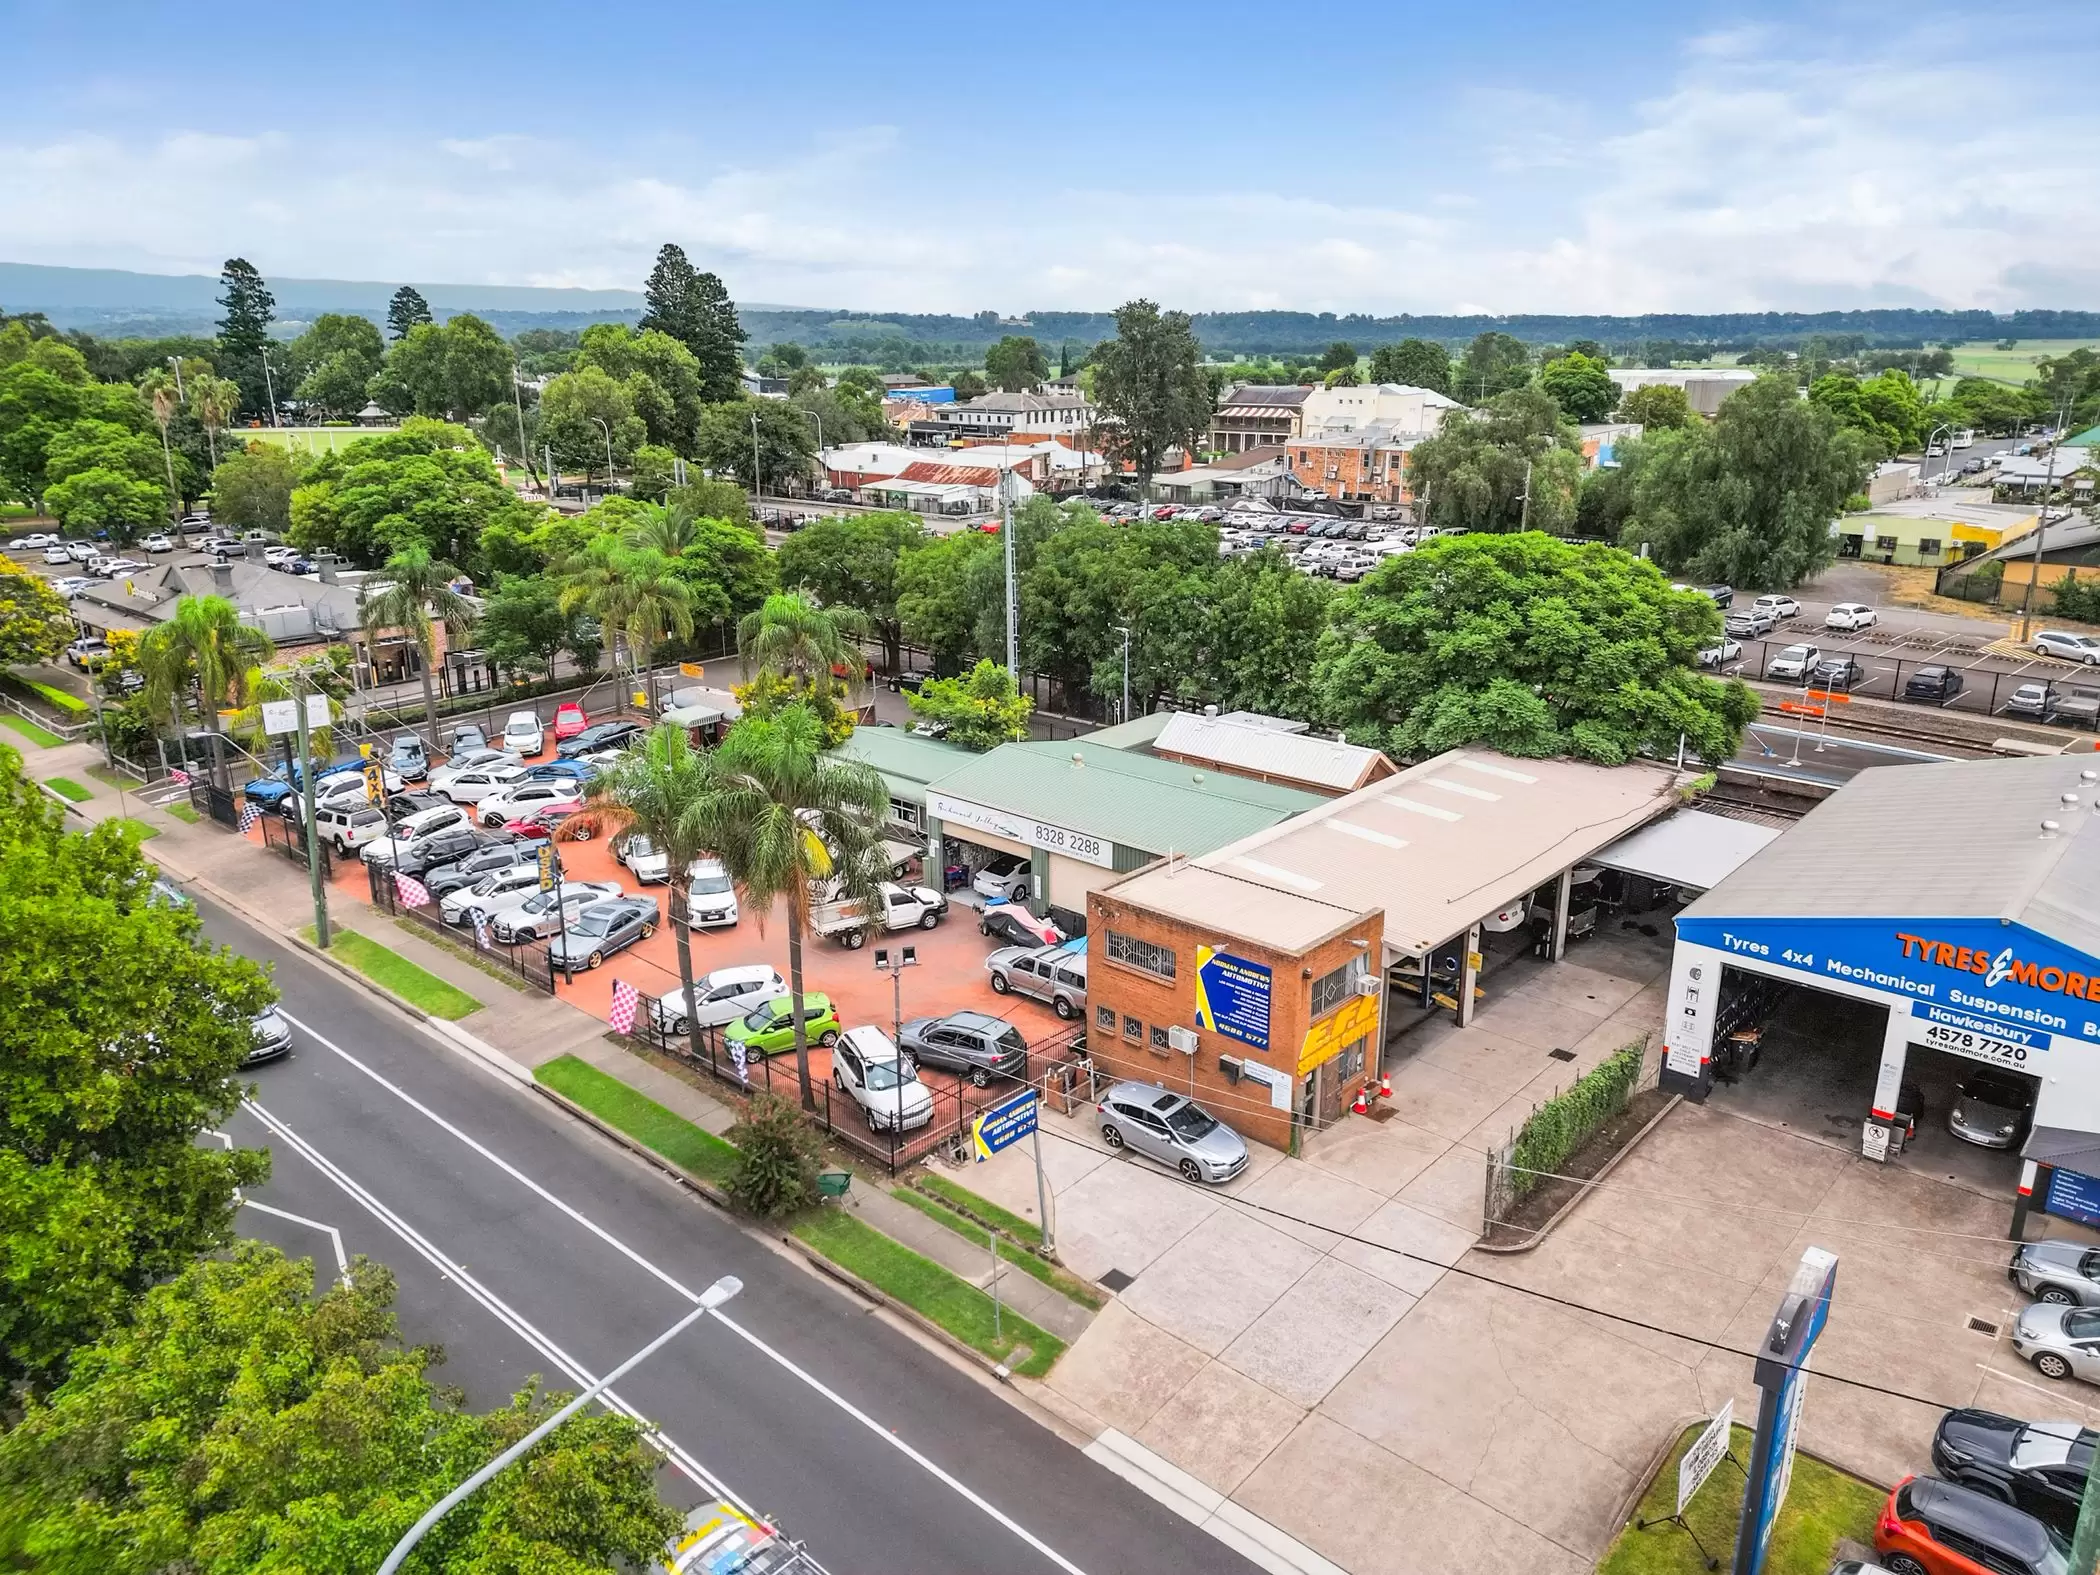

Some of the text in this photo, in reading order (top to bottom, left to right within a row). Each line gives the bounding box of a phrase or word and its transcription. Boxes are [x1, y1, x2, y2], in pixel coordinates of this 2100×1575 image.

[1035, 825, 1065, 846] 8328
[1070, 835, 1100, 856] 2288
[1221, 969, 1270, 991] AUTOMOTIVE
[1723, 932, 1770, 956] Tyres
[1782, 948, 1814, 967] 4x4
[1827, 958, 1935, 997] Mechanical
[1949, 989, 2067, 1030] Suspension
[1929, 1006, 2033, 1045] Hawkesbury
[1926, 1026, 2028, 1061] 4578 7720
[1926, 1038, 2026, 1069] tyresandmore.com.au
